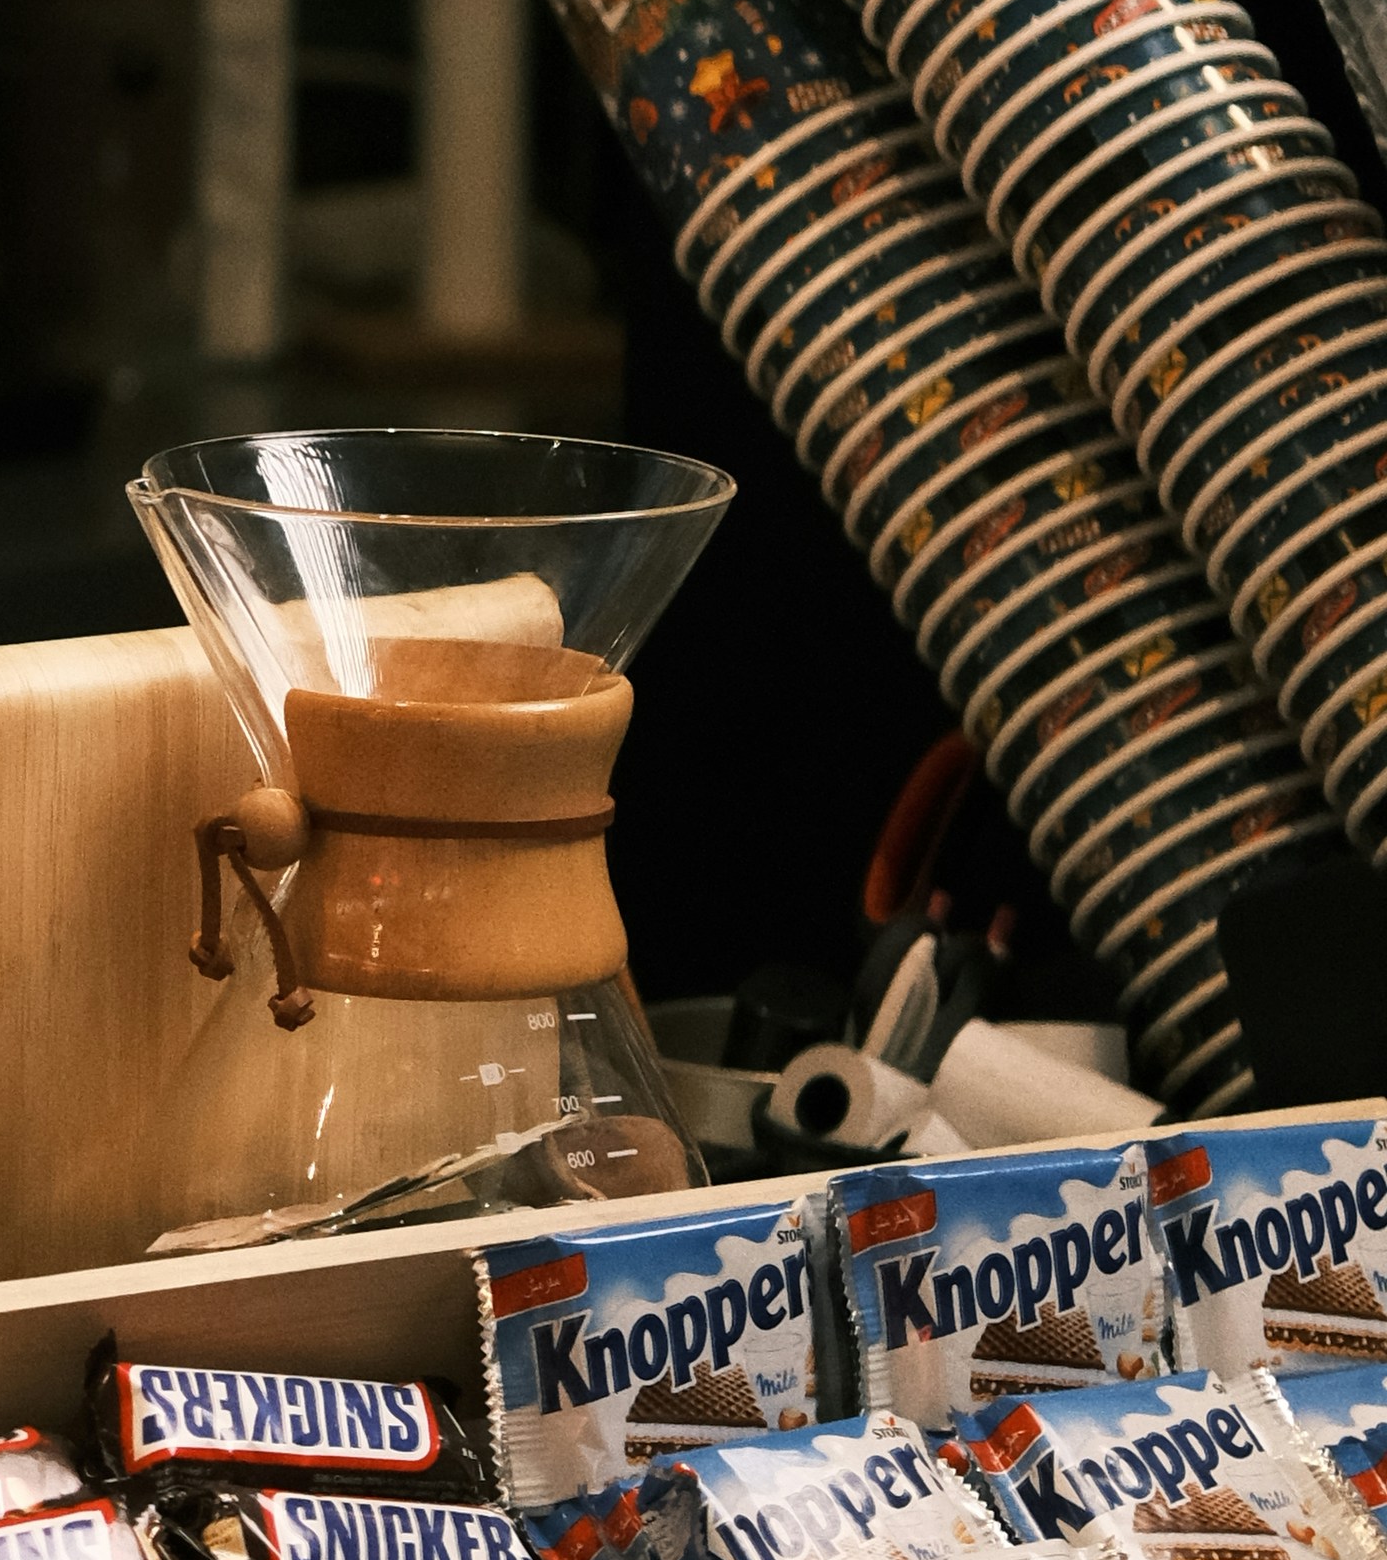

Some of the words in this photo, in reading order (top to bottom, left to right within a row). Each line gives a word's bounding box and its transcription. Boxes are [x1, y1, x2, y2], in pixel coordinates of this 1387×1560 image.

[527, 1012, 556, 1031] 800
[551, 1095, 580, 1113] 700
[566, 1149, 596, 1169] 600
[878, 1194, 1147, 1352] Knopper
[1163, 1166, 1387, 1308] Knoppe
[531, 1246, 811, 1415] Knopper
[139, 1367, 421, 1453] SNICKERS
